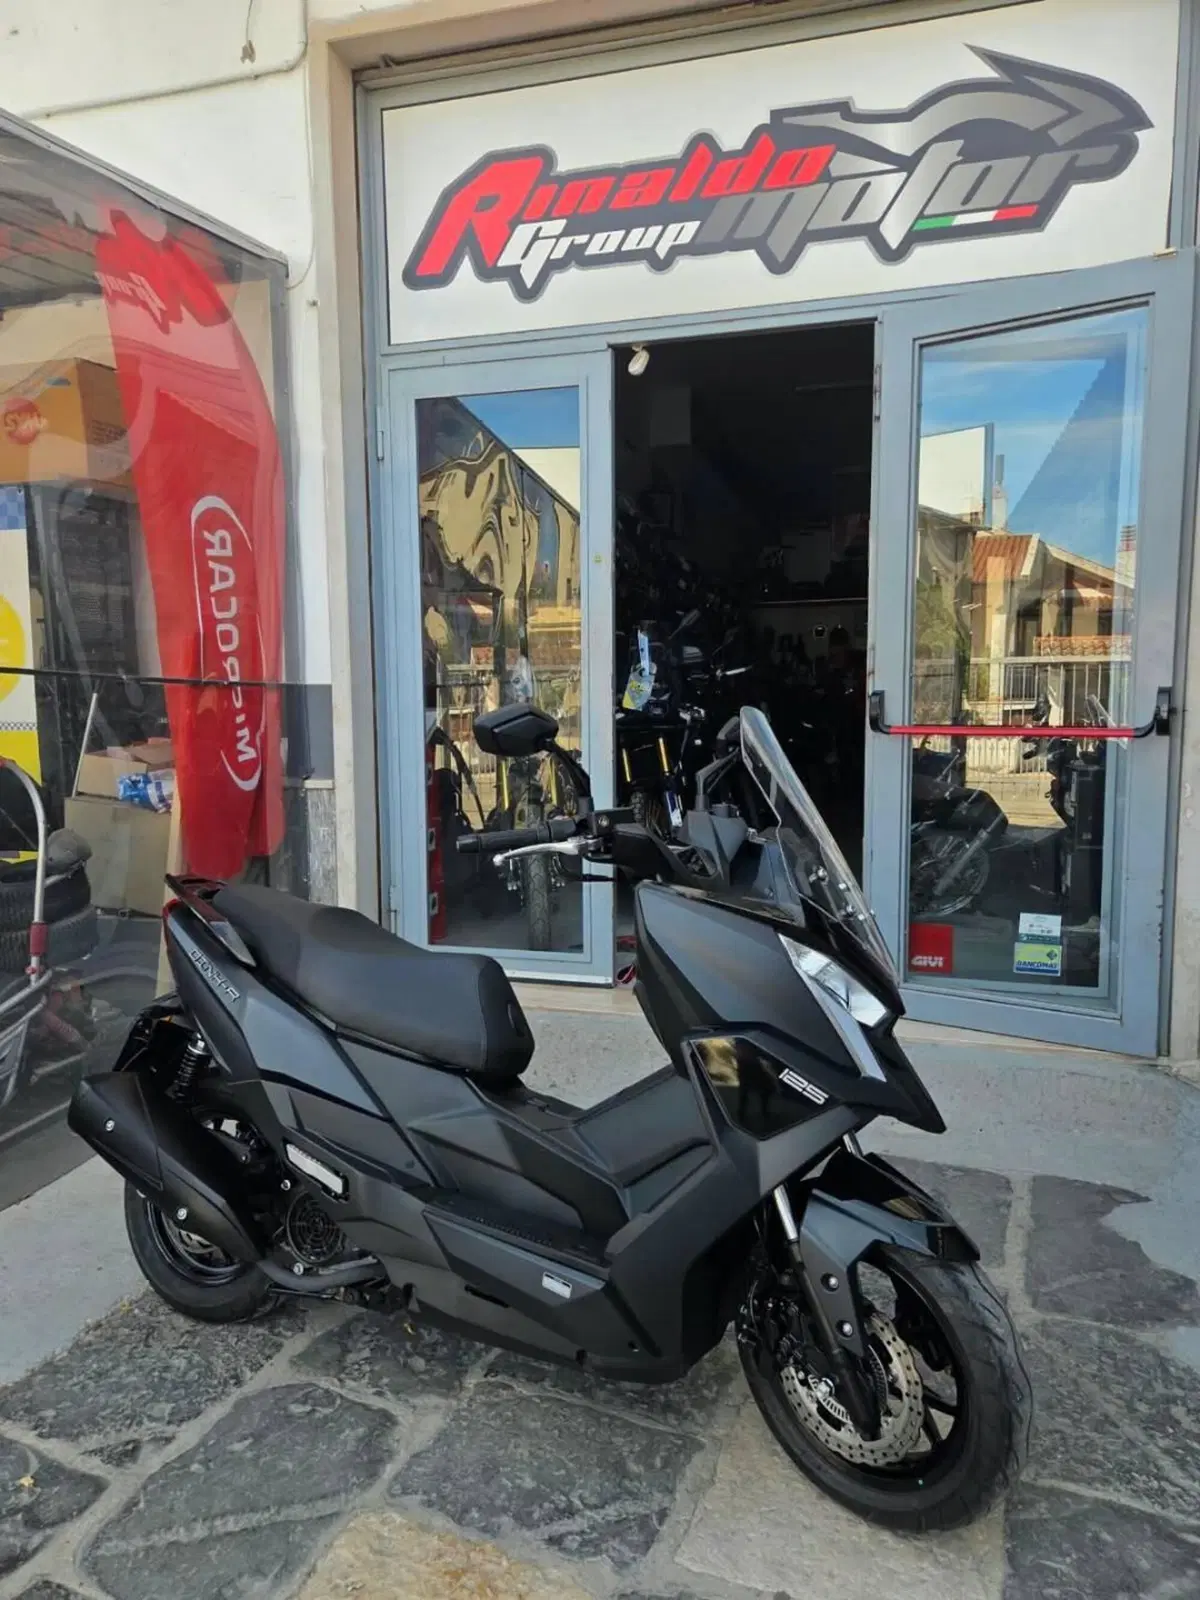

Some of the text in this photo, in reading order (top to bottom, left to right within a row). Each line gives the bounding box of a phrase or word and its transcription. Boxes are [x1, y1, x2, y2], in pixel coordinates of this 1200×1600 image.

[496, 218, 701, 289] Group
[911, 955, 945, 968] GIVI
[778, 1067, 829, 1105] 125
